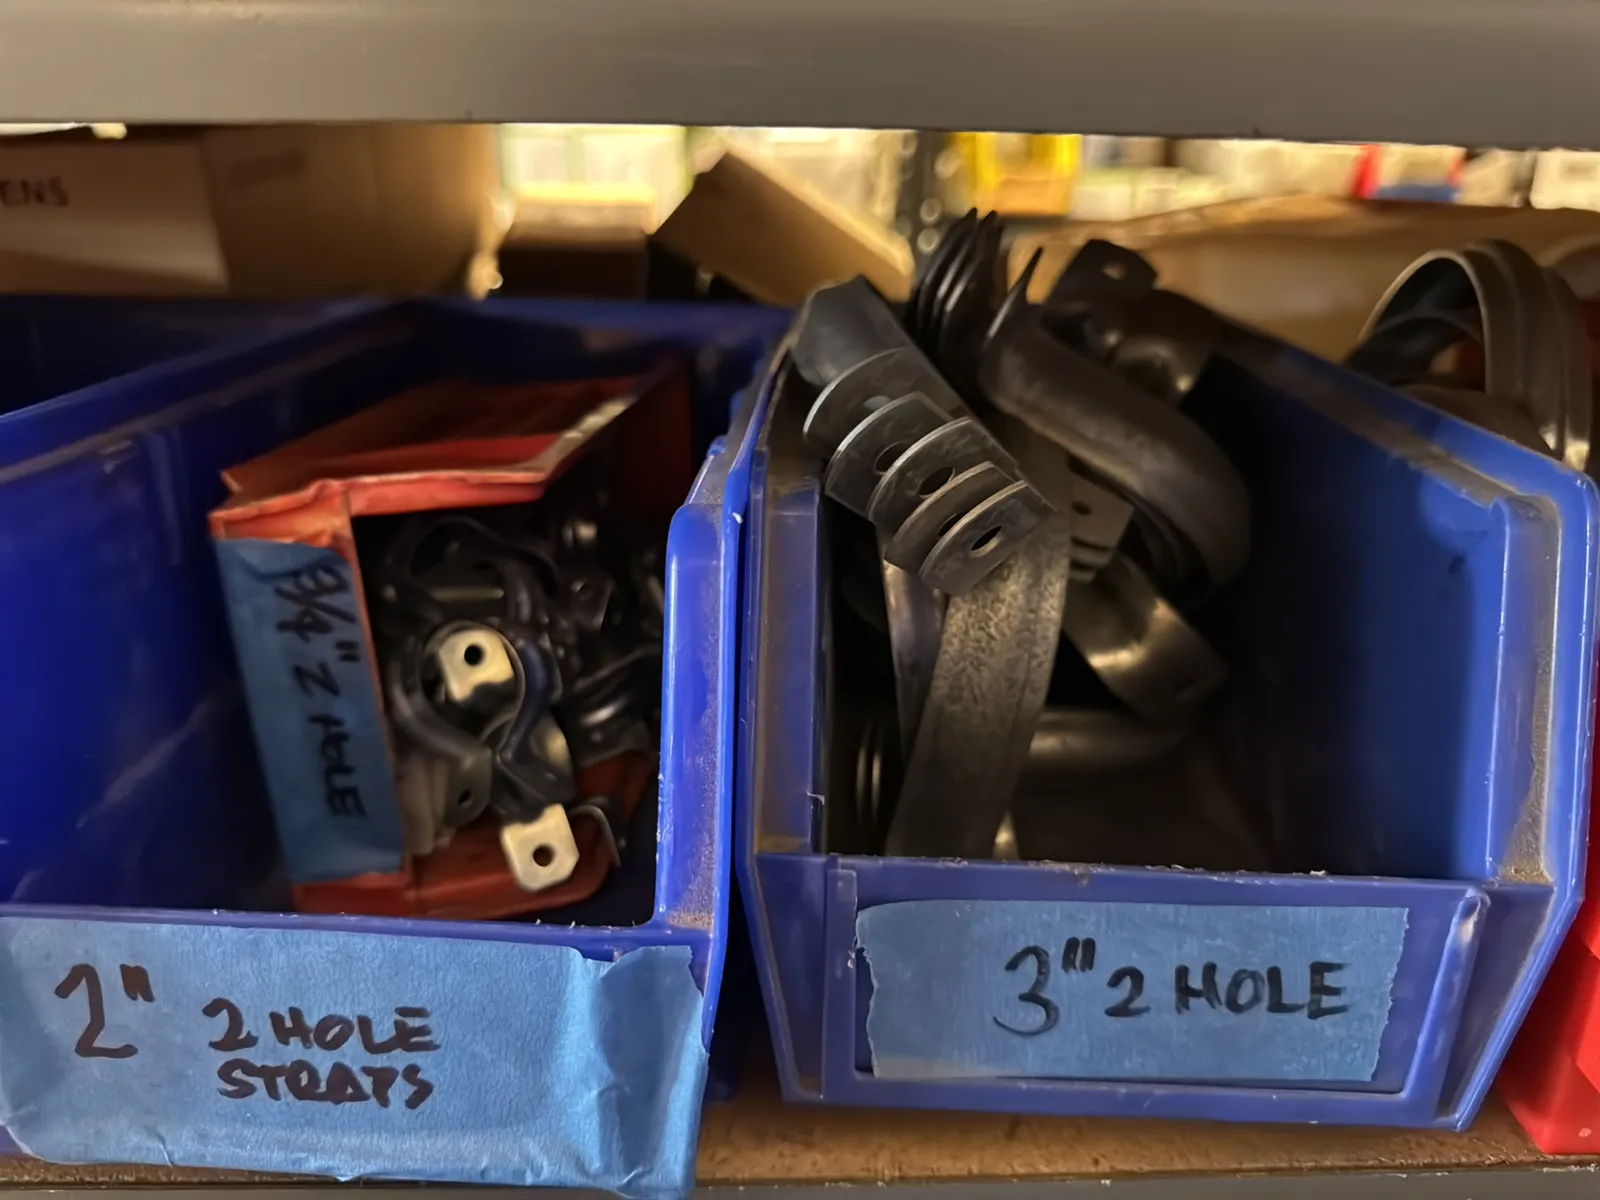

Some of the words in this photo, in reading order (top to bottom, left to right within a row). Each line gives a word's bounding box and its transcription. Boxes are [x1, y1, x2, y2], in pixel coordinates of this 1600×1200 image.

[307, 714, 368, 818] HOLE
[202, 997, 259, 1051] 2
[269, 1006, 440, 1055] HOLE
[992, 936, 1096, 1037] 3"
[1104, 965, 1151, 1018] 2
[1174, 961, 1349, 1020] HOLE
